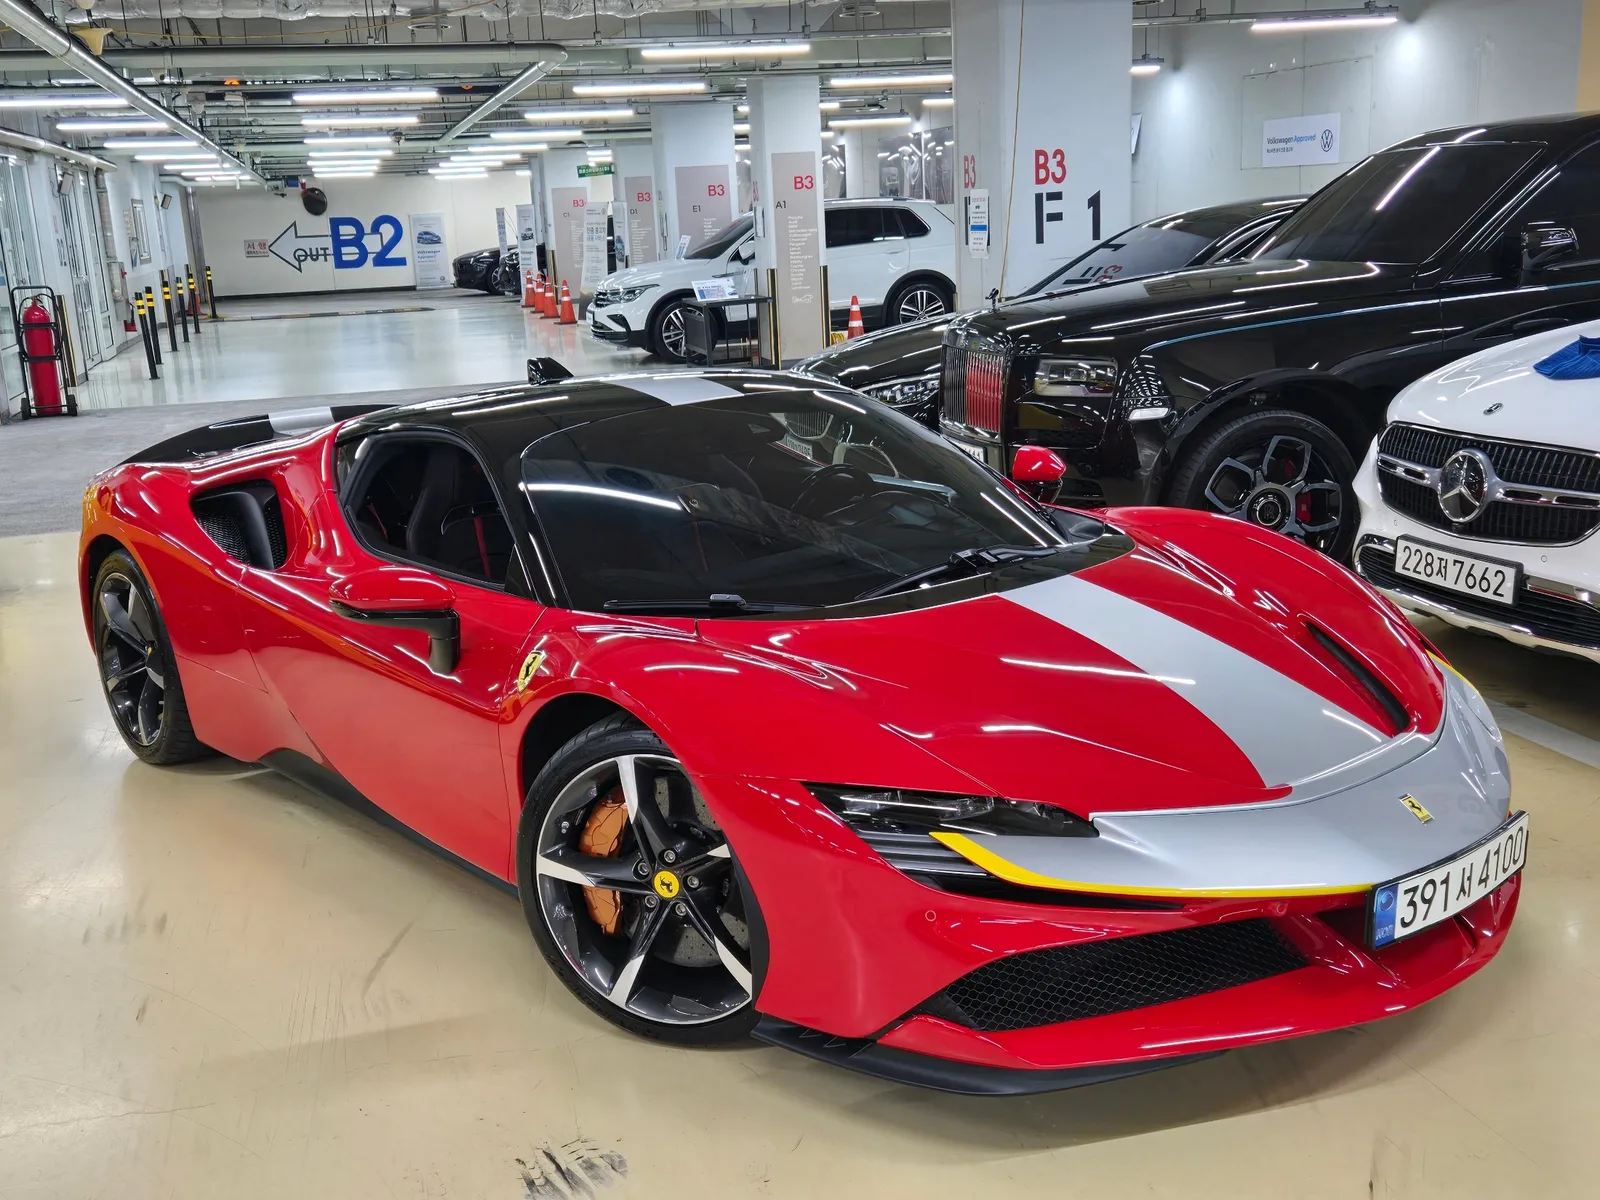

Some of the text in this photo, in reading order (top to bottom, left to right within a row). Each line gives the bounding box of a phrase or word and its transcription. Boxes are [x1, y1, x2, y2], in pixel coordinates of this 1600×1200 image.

[1266, 132, 1316, 144] Volkswagen Approved
[963, 154, 976, 189] B3
[1034, 148, 1067, 185] B3
[793, 175, 814, 190] B3
[637, 192, 651, 202] B3
[707, 184, 725, 197] B3
[572, 199, 585, 208] B3
[692, 205, 701, 213] E1
[775, 200, 787, 209] A1
[329, 214, 408, 269] B2
[293, 247, 330, 264] OUT
